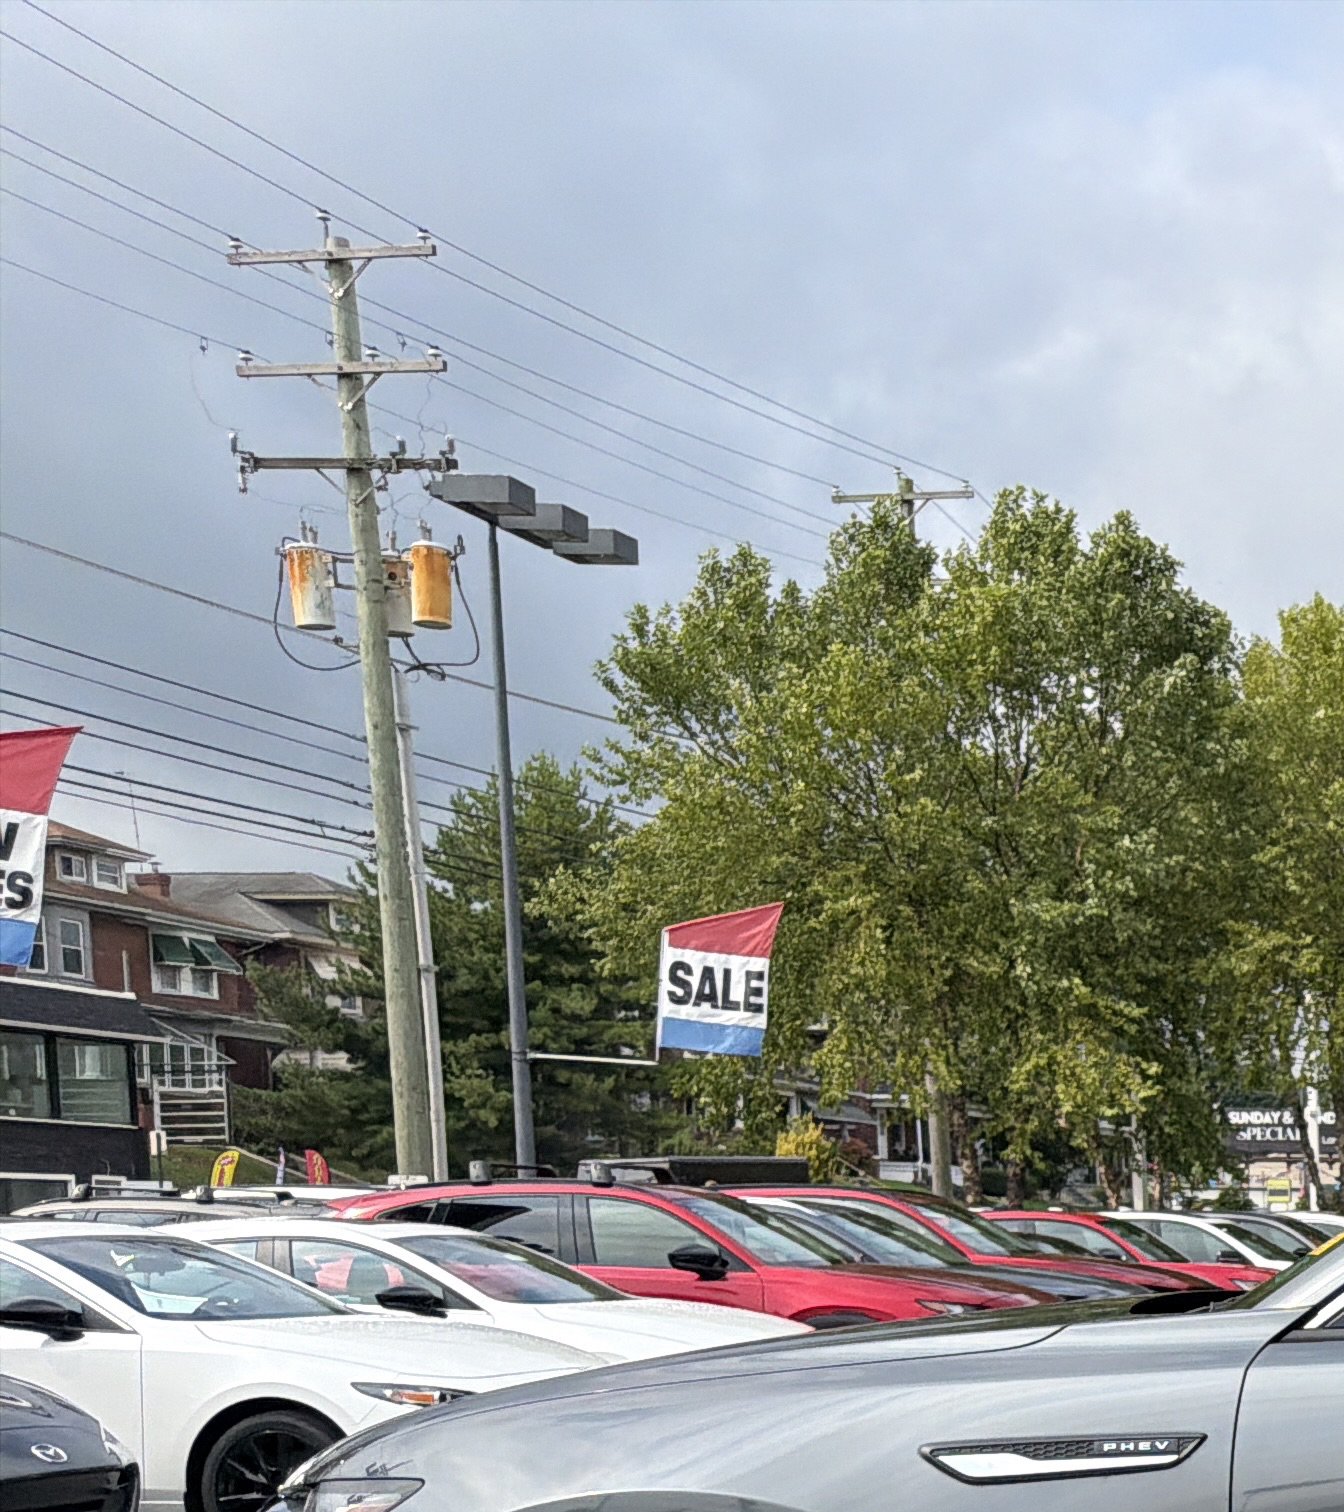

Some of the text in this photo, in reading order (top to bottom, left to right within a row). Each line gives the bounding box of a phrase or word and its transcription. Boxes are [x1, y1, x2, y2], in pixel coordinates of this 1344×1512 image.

[667, 960, 765, 1014] SALE
[1228, 1111, 1294, 1125] SUNDAY &
[1103, 1441, 1169, 1452] PHEV
